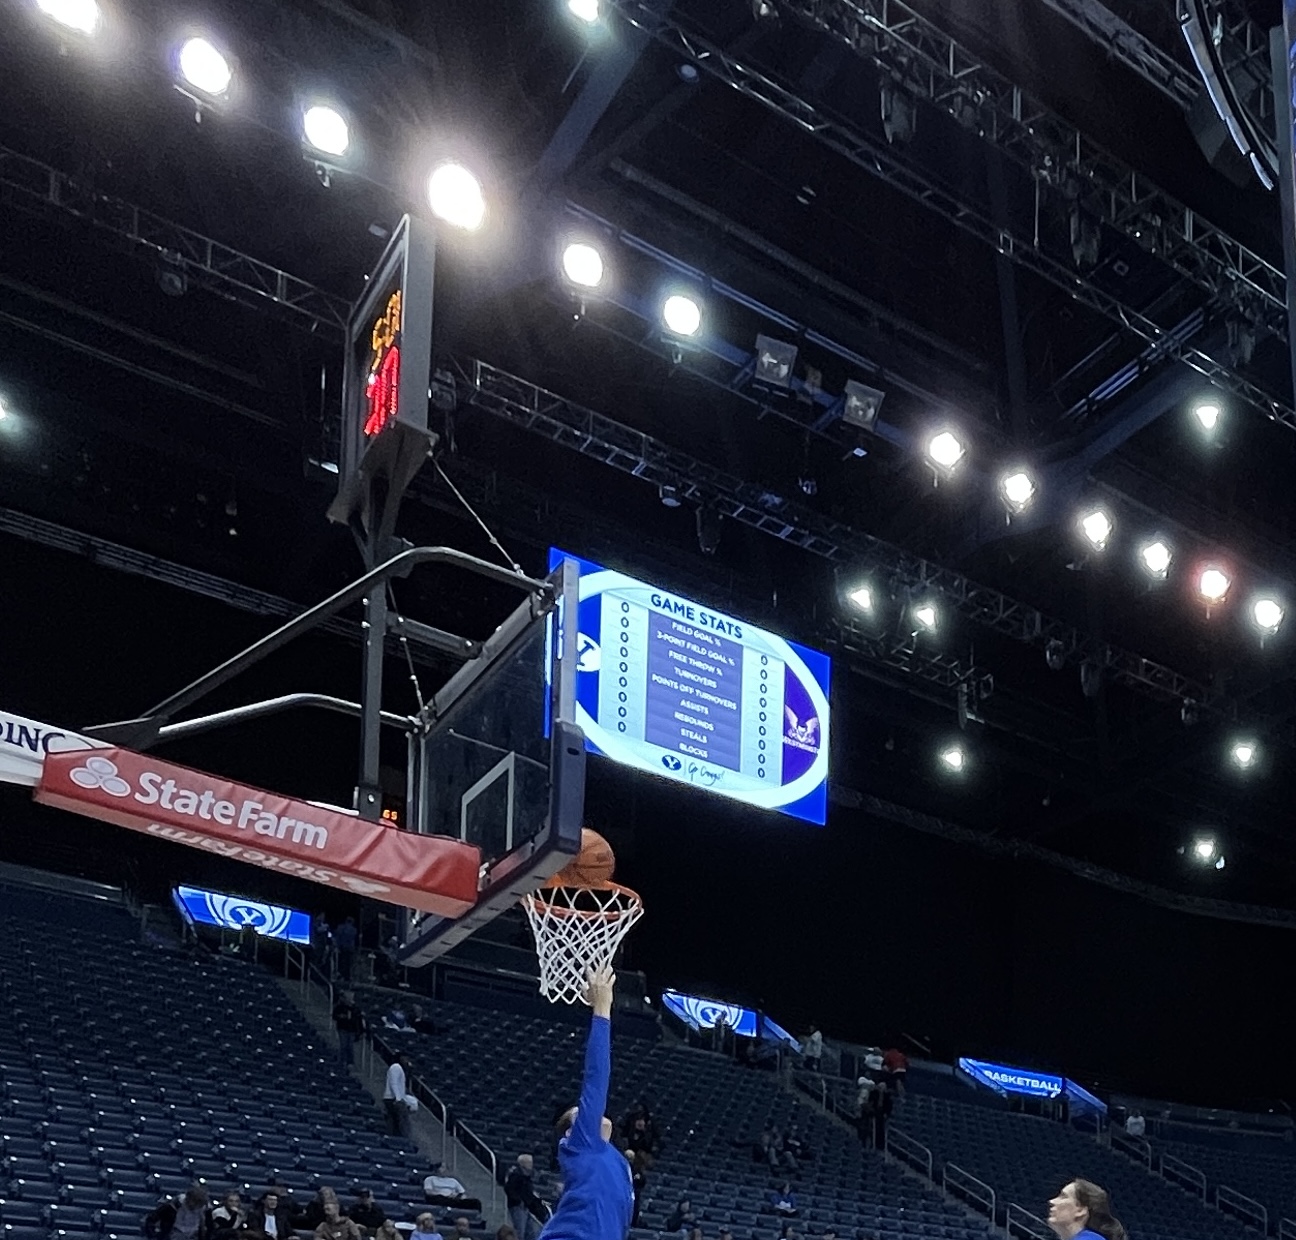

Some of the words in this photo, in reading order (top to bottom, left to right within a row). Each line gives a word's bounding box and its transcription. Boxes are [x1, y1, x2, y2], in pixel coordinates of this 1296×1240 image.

[621, 602, 629, 613] 0
[651, 594, 695, 621] GAME
[700, 612, 743, 638] STATS
[621, 617, 629, 628] 0
[620, 632, 628, 643] 0
[672, 621, 693, 635] FIELD
[694, 629, 713, 644] GOAL
[620, 646, 628, 658] 0
[686, 641, 707, 656] FIELD
[708, 650, 727, 664] GOAL
[668, 650, 688, 664] FREE
[688, 657, 715, 673] THROW
[760, 655, 768, 666] 0
[620, 662, 628, 672] 0
[674, 666, 717, 689] TURNOVERS
[760, 670, 768, 680] 0
[619, 676, 627, 687] 0
[652, 673, 678, 690] POINTS
[695, 688, 737, 710] TURNOVERS
[759, 683, 767, 694] 0
[619, 691, 627, 702] 0
[680, 699, 709, 715] ASSISTS
[759, 697, 767, 708] 0
[618, 706, 626, 717] 0
[759, 711, 767, 722] 0
[618, 721, 626, 732] 0
[674, 711, 714, 731] REBOUNDS
[681, 728, 708, 744] STEALS
[758, 725, 766, 736] 0
[679, 742, 708, 759] BLOCKS
[758, 740, 766, 750] 0
[758, 754, 766, 764] 0
[757, 768, 765, 778] 0
